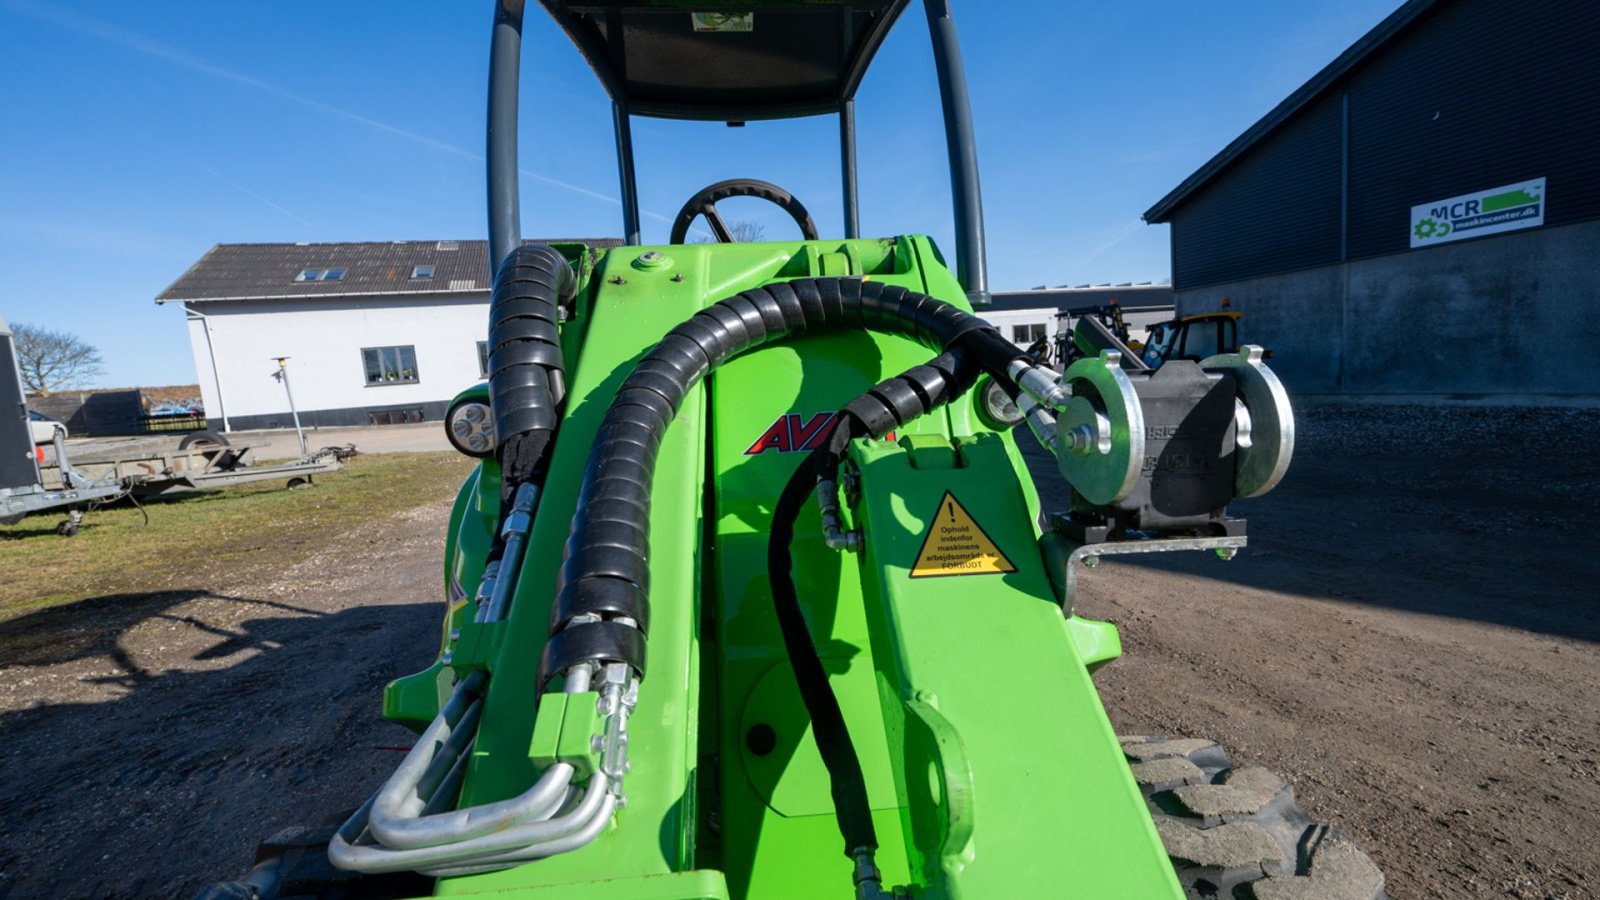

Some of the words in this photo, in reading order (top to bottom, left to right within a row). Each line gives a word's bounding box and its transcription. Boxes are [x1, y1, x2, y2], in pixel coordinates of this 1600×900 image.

[1431, 200, 1480, 220] MCR
[1455, 207, 1536, 229] maskincenter.dk
[942, 561, 982, 569] FORBUDT
